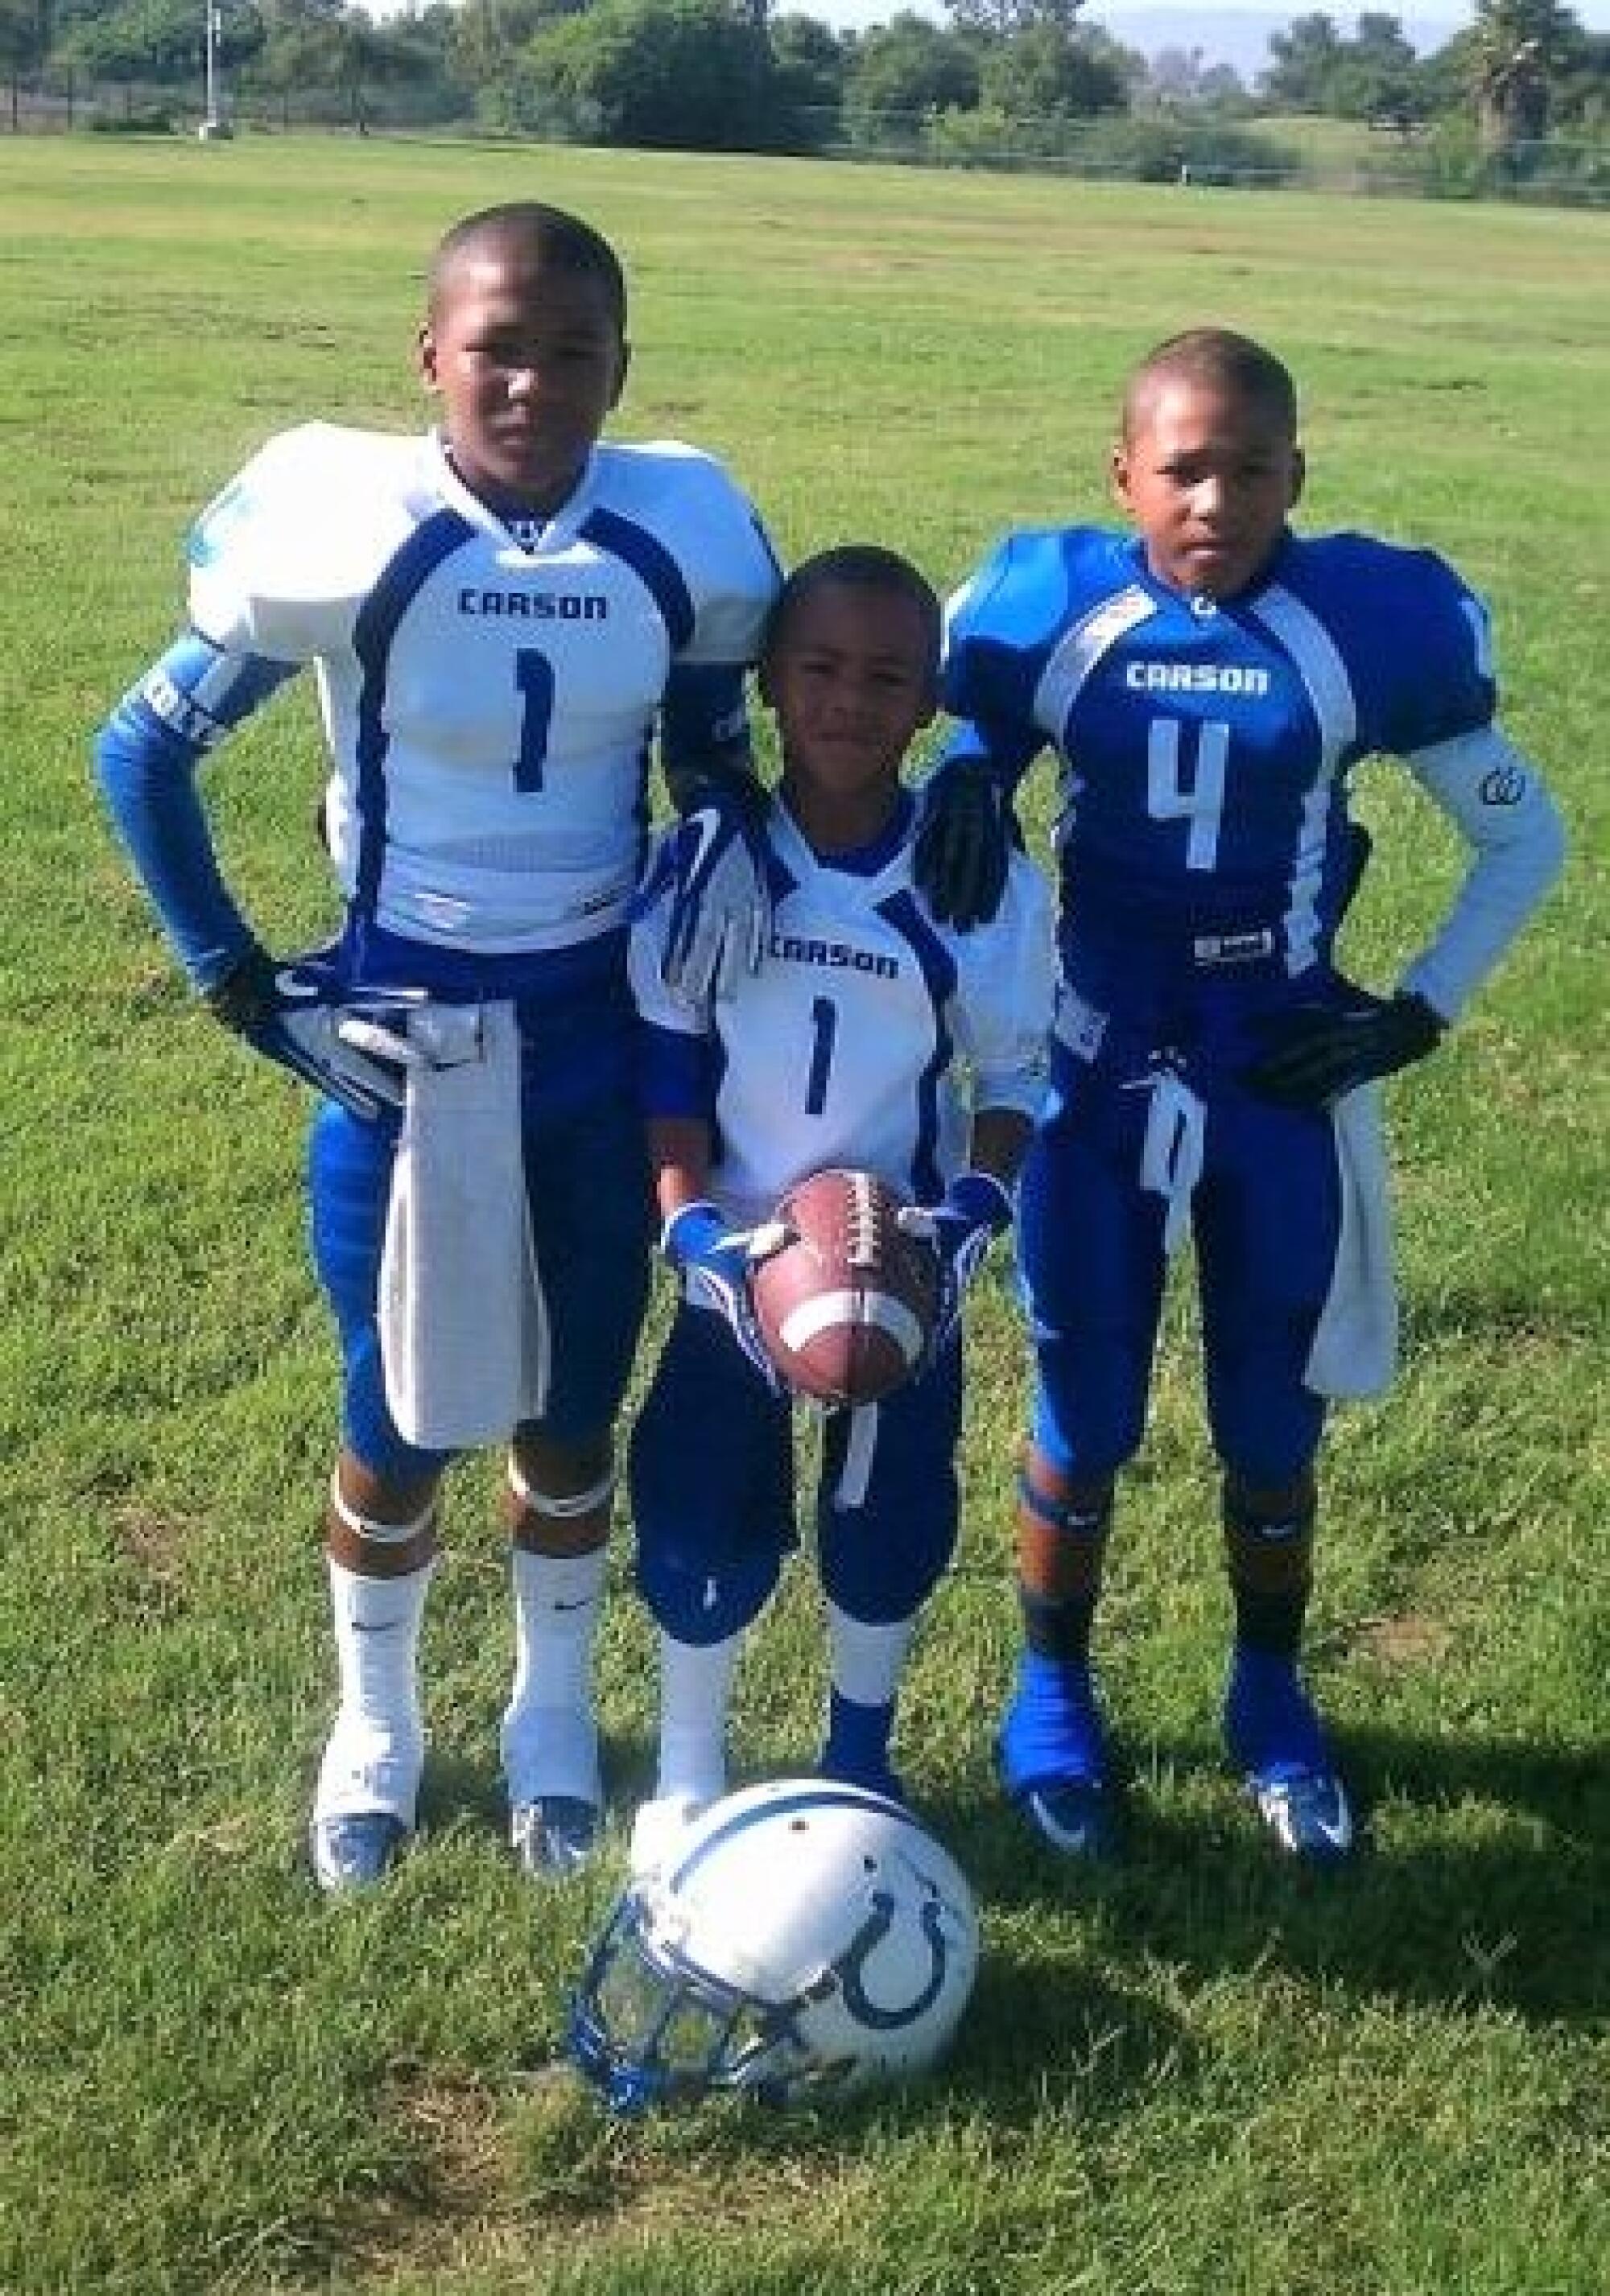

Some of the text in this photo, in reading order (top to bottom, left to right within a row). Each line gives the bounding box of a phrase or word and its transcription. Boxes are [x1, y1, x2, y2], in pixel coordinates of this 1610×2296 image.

[457, 588, 609, 619] CARSON
[513, 648, 555, 793] 1
[1126, 663, 1270, 696] CARSON
[1148, 720, 1228, 870] 4
[768, 935, 899, 979] CARSON
[806, 995, 836, 1116] 1
